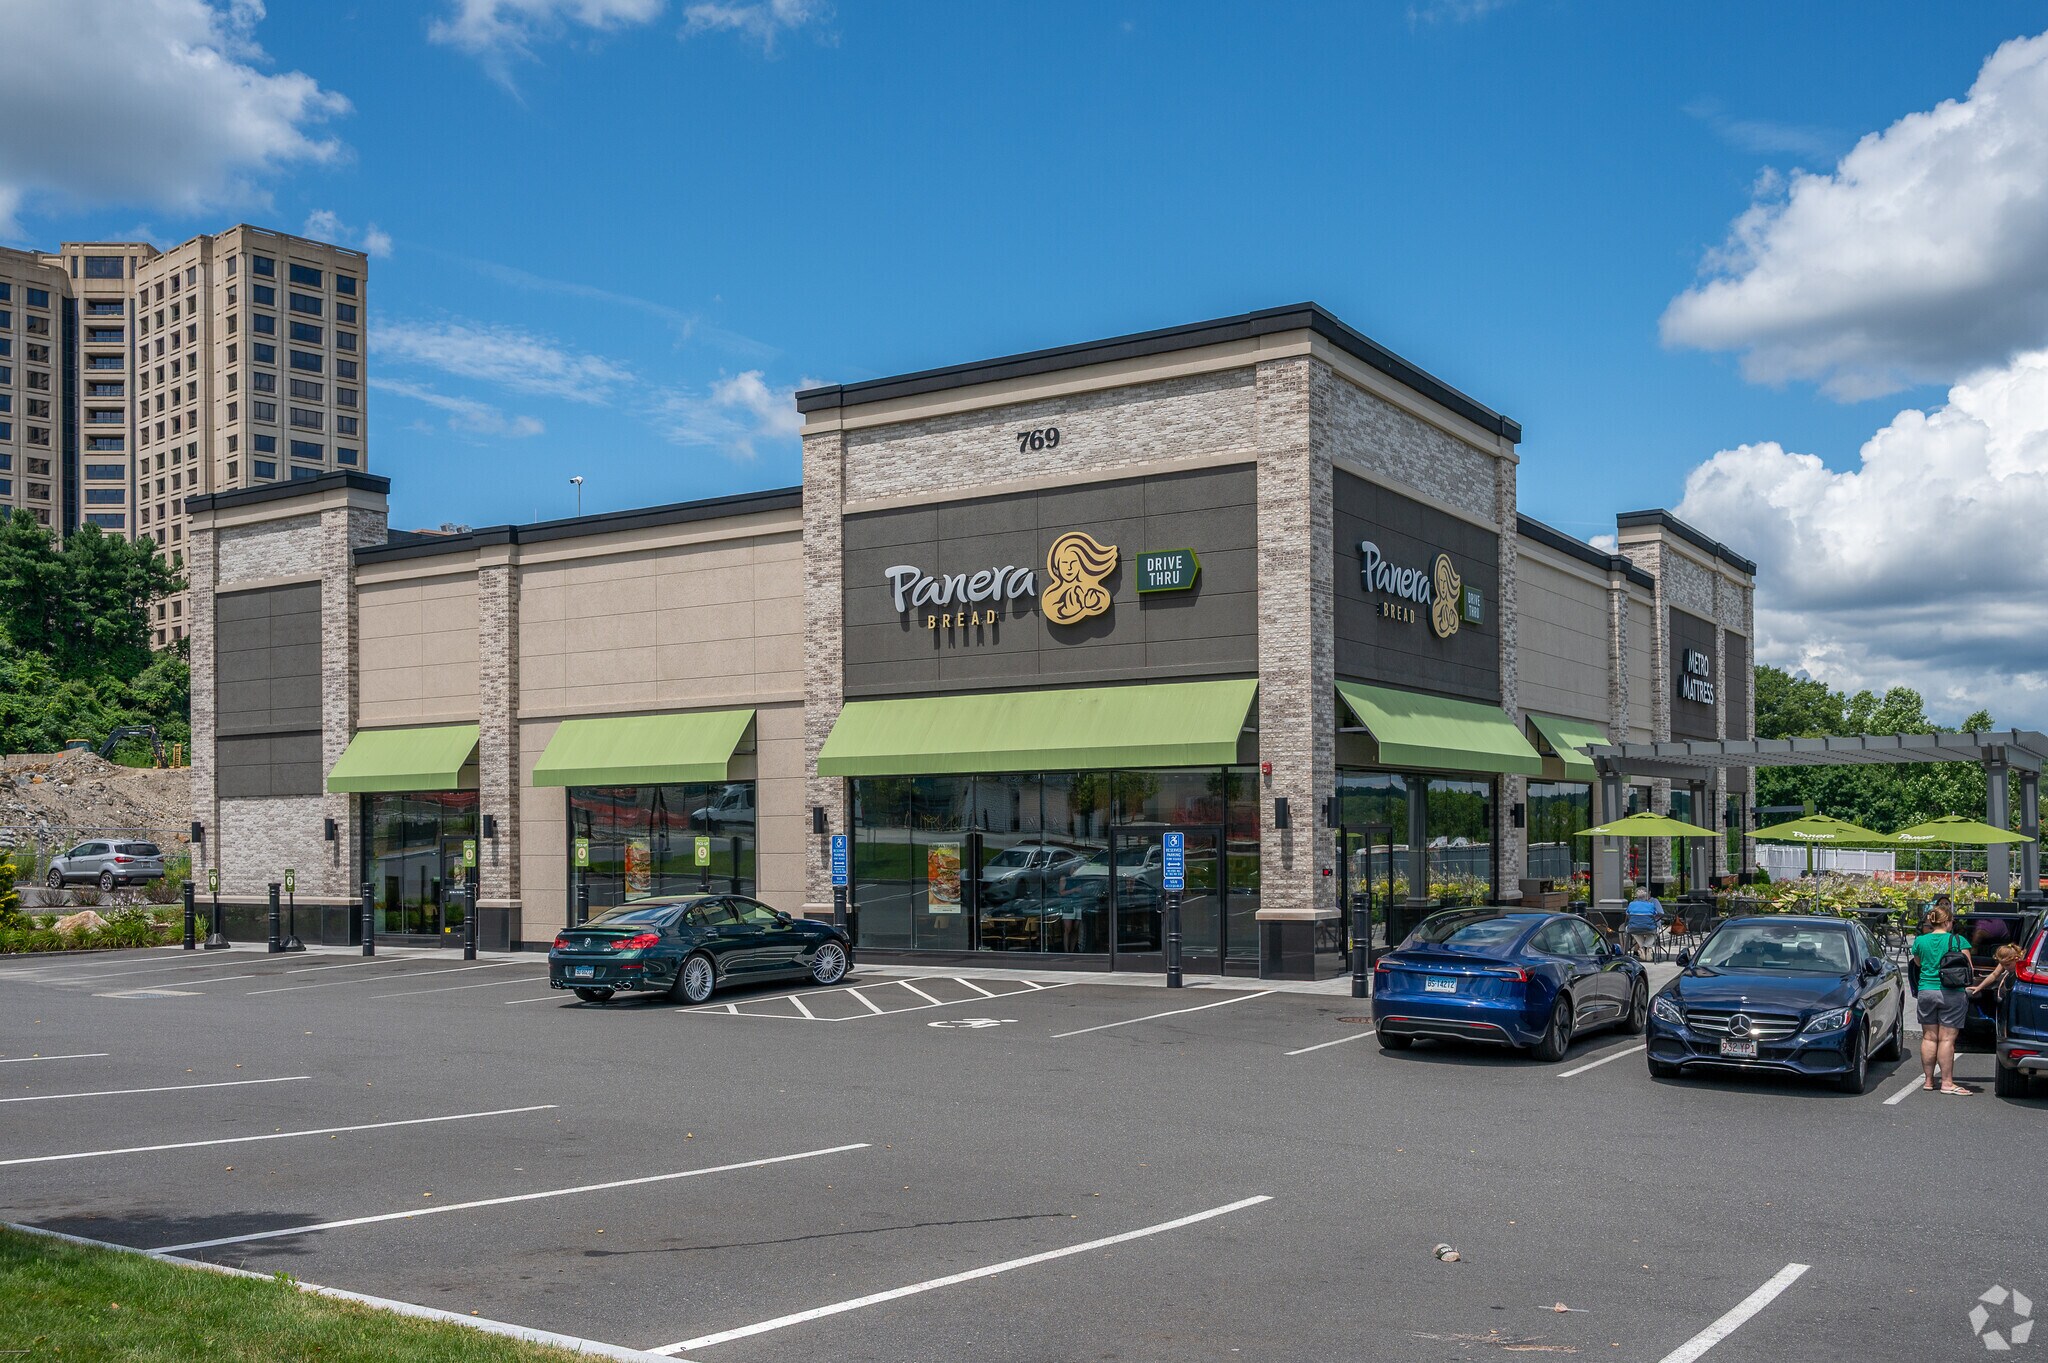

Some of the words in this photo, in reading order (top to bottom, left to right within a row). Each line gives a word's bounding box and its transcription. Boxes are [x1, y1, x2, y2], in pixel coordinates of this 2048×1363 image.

[1016, 427, 1060, 454] 769
[1147, 555, 1183, 572] DRIVE
[1361, 540, 1431, 605] Panera
[884, 564, 1035, 613] Panera
[1149, 570, 1180, 586] THRU
[1467, 592, 1481, 606] DRIVE
[927, 609, 996, 630] BREAD
[1383, 601, 1415, 624] BREAD
[1468, 605, 1480, 619] THRU
[1687, 648, 1709, 677] METRO
[1682, 673, 1714, 705] MATTRESS
[1722, 1042, 1738, 1052] 932
